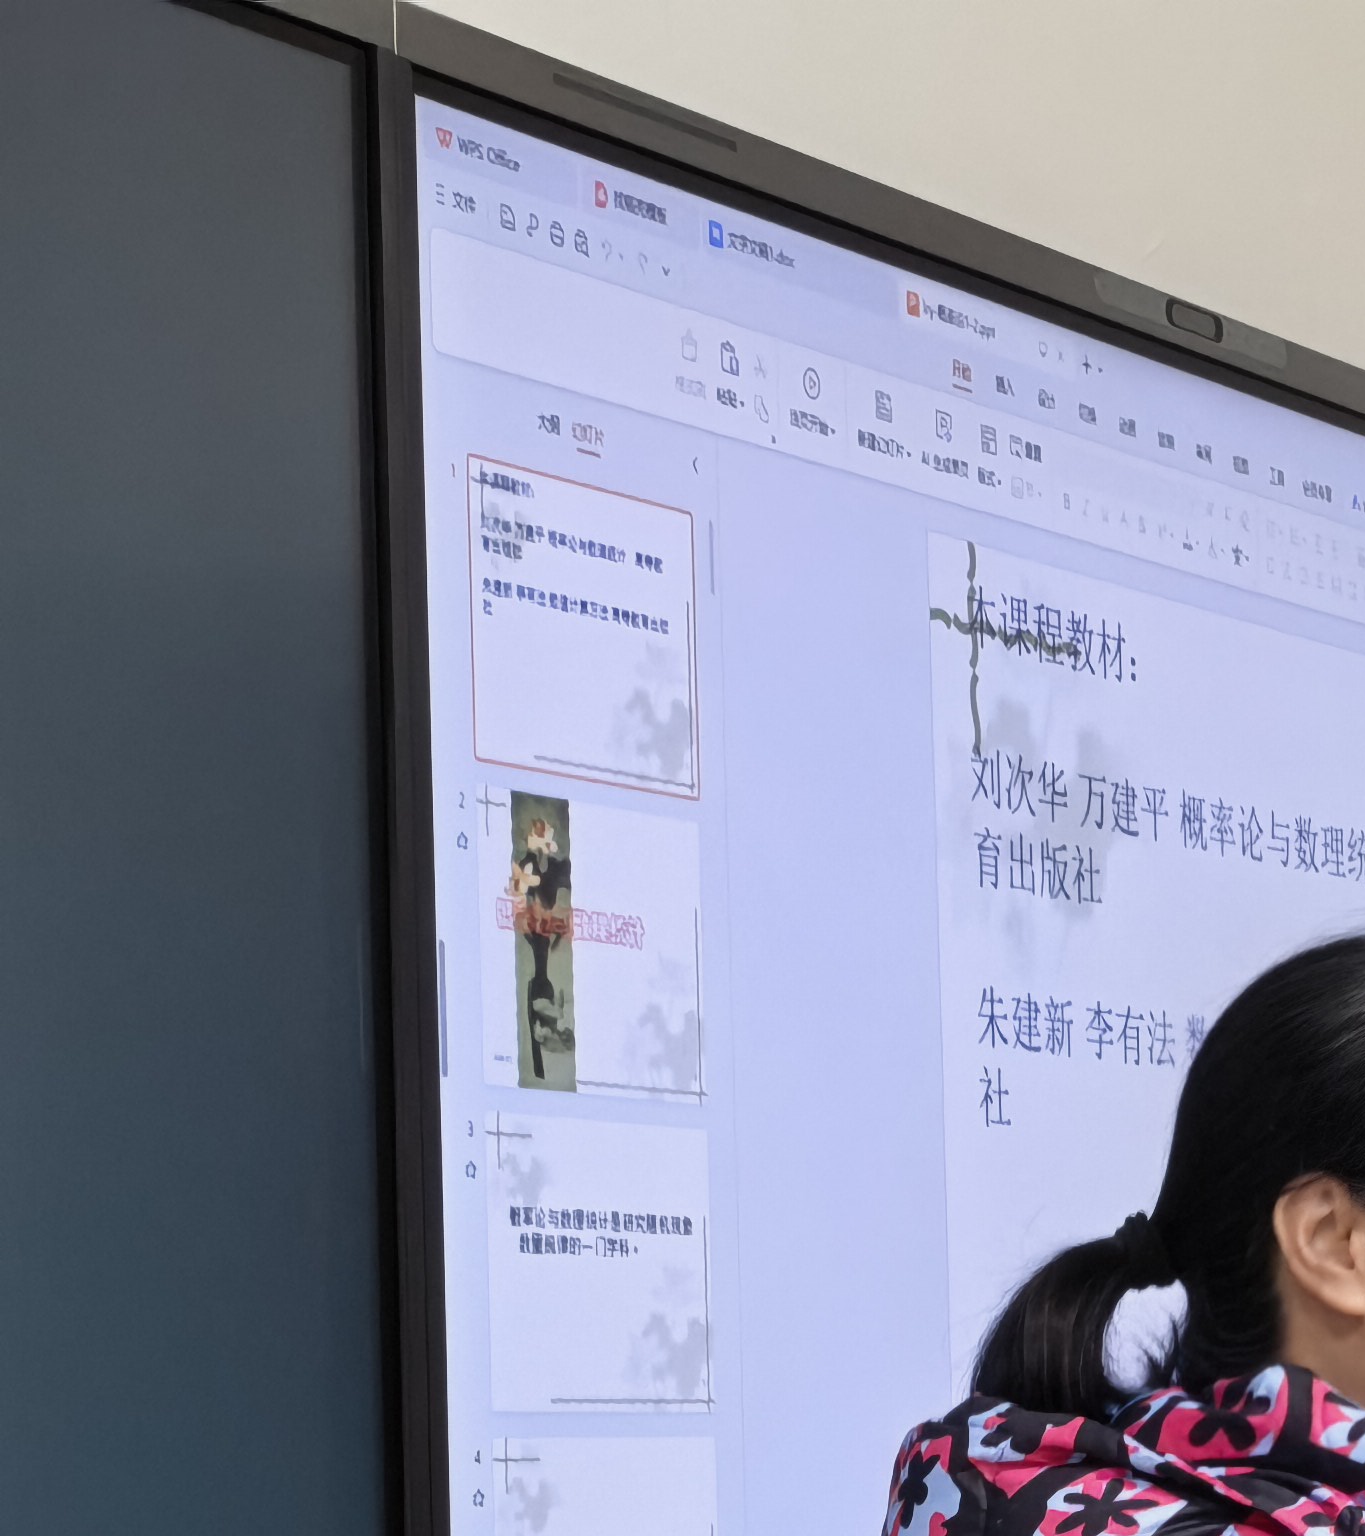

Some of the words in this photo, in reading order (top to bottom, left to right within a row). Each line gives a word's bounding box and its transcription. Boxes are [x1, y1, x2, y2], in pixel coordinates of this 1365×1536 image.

[971, 747, 1068, 823] 刘次华
[1078, 771, 1169, 841] 万建平
[973, 826, 1104, 905] 育出版社
[976, 985, 1073, 1058] 朱建新
[1084, 1001, 1176, 1067] 李有法
[979, 1065, 1012, 1127] 社
